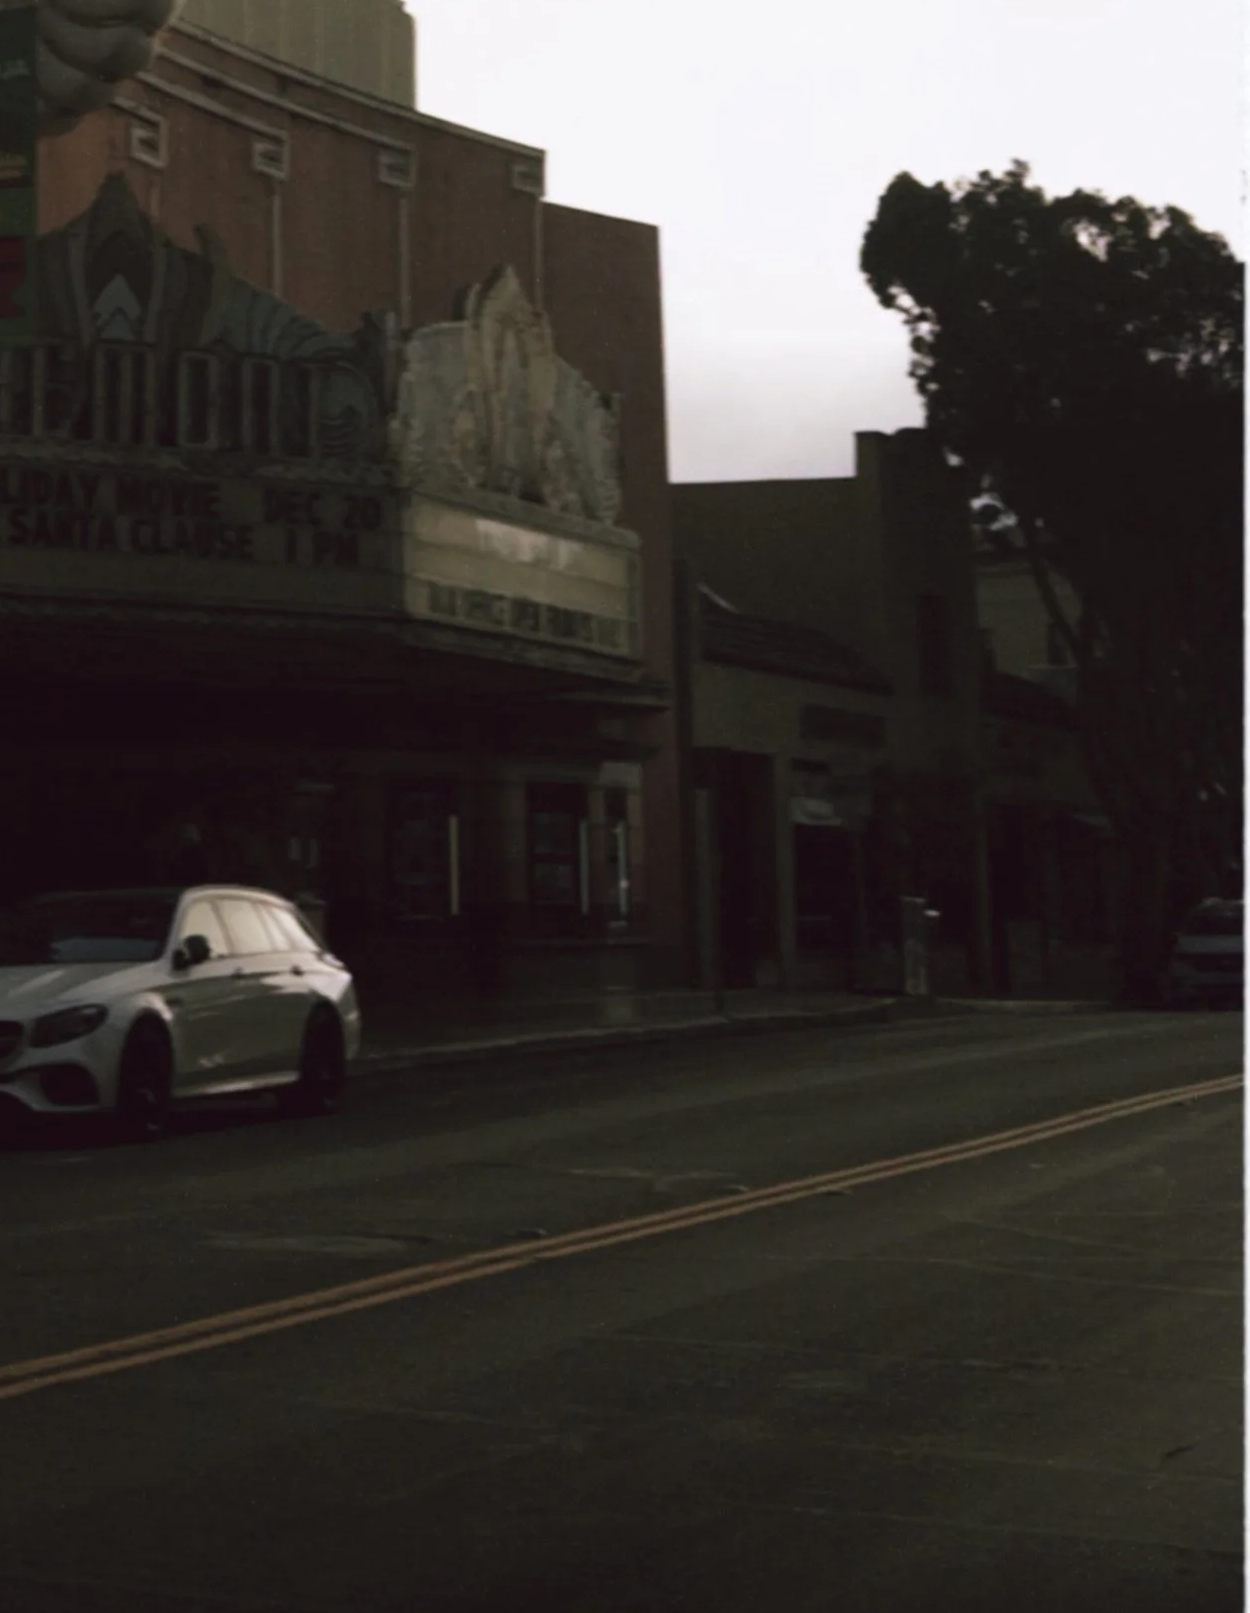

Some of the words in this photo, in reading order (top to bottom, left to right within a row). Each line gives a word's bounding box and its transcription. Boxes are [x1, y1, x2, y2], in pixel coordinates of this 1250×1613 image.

[114, 471, 220, 519] MOVIE
[263, 487, 323, 526] DEC
[340, 493, 382, 531] 20
[9, 508, 117, 554] SANTA
[131, 518, 253, 562] CLAUSE
[312, 530, 359, 567] PM
